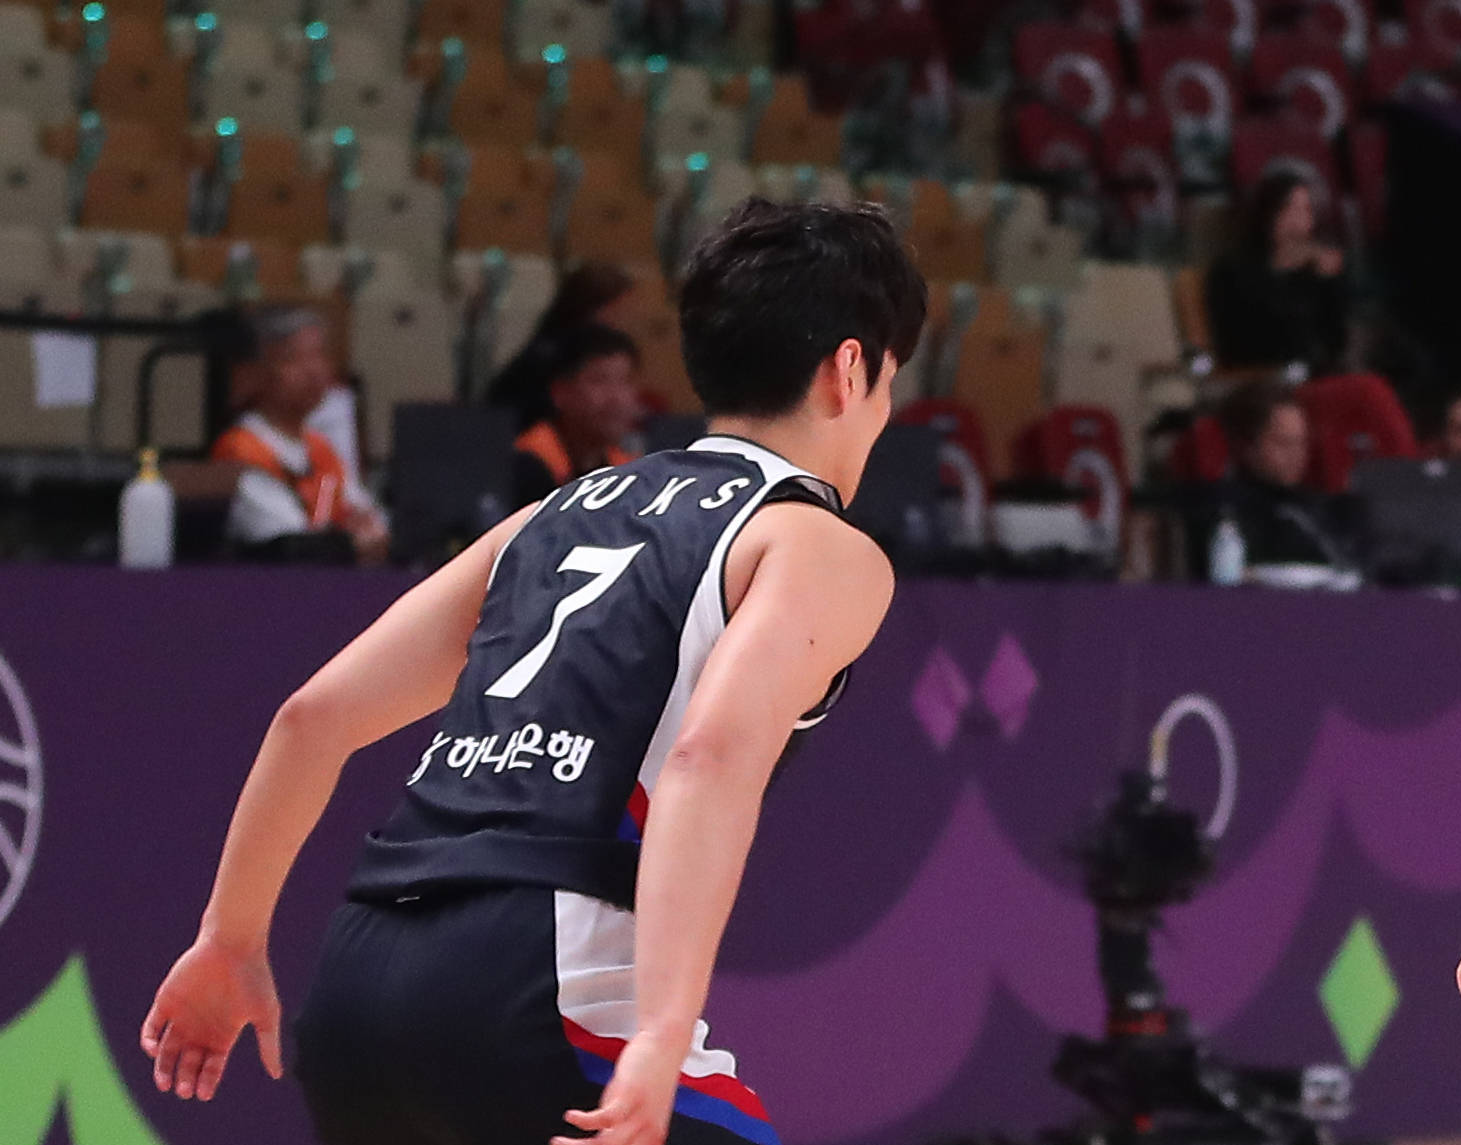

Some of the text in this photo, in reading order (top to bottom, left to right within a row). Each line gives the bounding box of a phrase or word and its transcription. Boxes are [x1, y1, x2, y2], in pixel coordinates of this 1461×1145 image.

[558, 474, 750, 516] YU K S
[484, 542, 647, 700] 7
[446, 722, 596, 783] 하나은행
